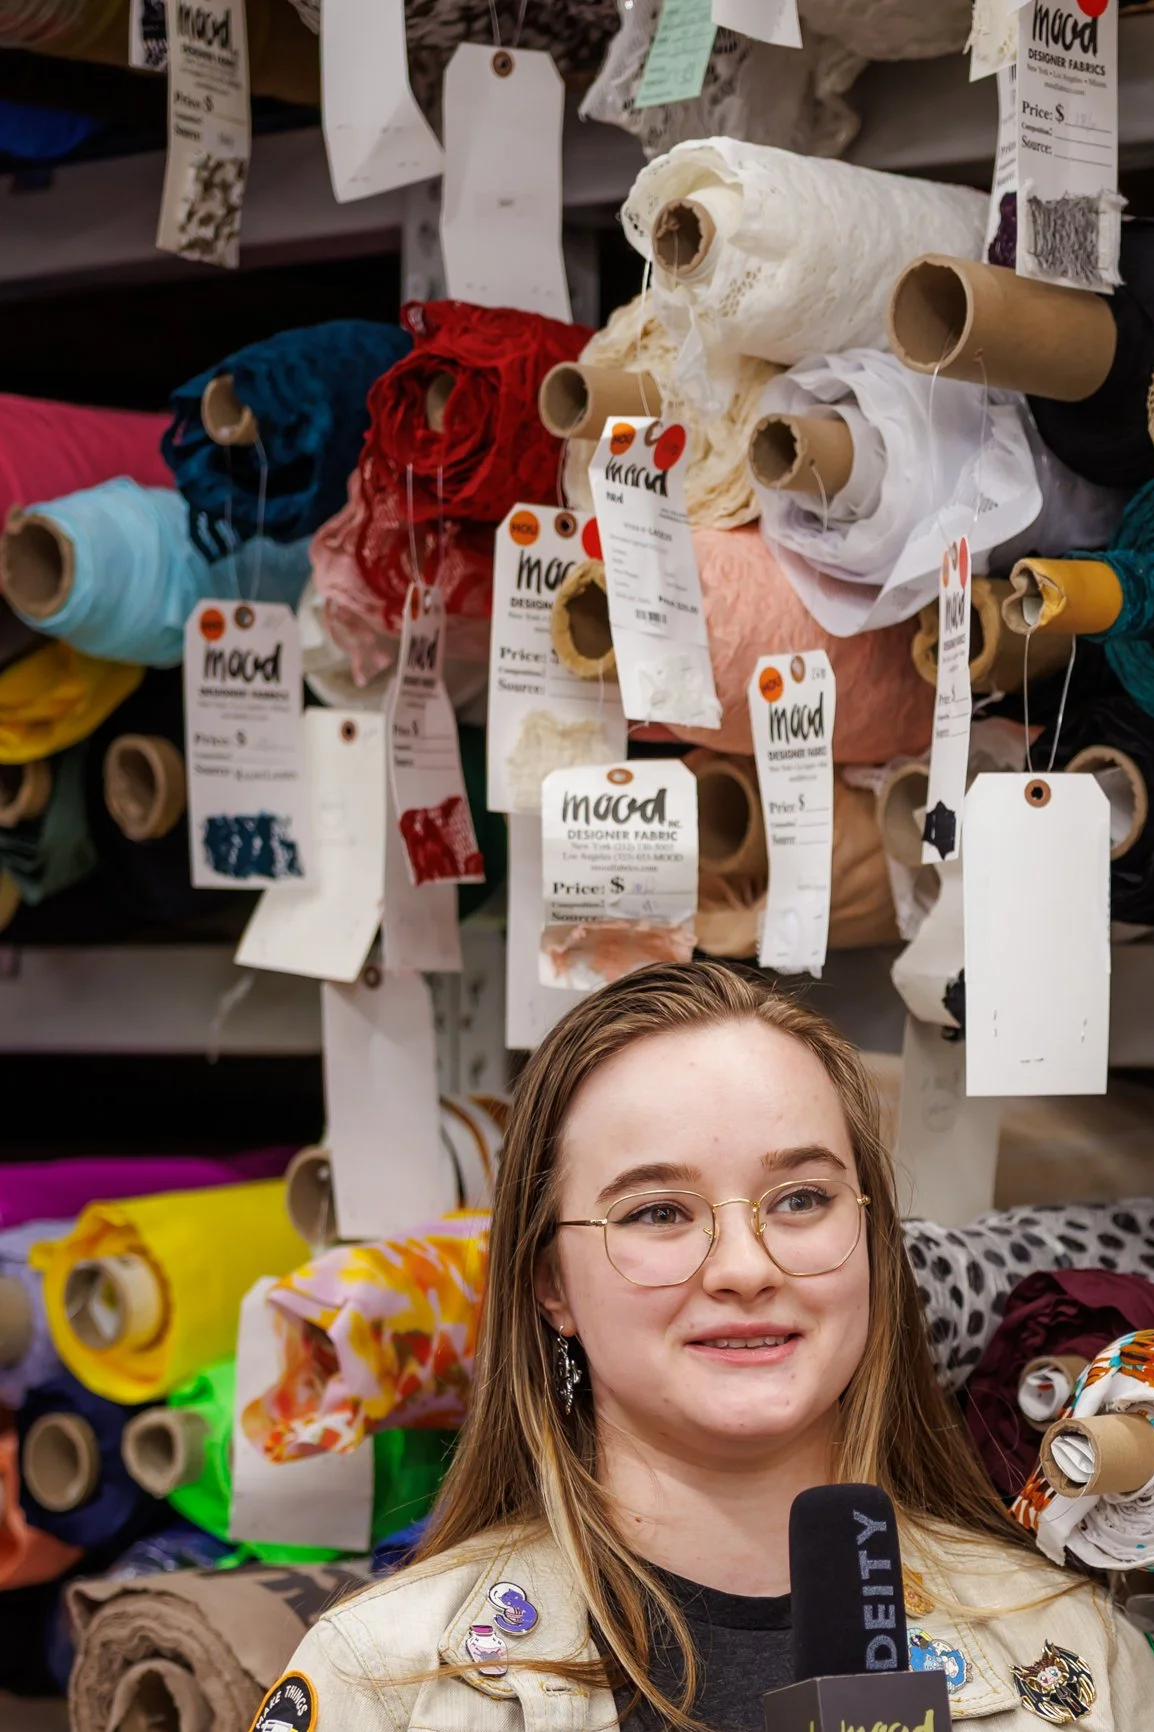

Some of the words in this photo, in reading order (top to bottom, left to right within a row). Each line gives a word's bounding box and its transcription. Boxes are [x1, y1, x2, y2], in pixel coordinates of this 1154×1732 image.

[1032, 0, 1098, 57] mood
[1028, 48, 1067, 69] DESIGNER
[1068, 59, 1106, 77] FABRICS
[1022, 100, 1053, 120] Price:
[1055, 103, 1065, 123] $
[1021, 135, 1053, 155] Source:
[516, 550, 575, 595] mo
[204, 642, 283, 685] mood
[500, 647, 547, 663] Price:
[769, 691, 825, 745] mood
[562, 788, 667, 826] mood
[567, 829, 629, 841] DESIGNER
[634, 831, 678, 841] FABRIC
[553, 881, 605, 895] Price:
[610, 876, 625, 895] $
[853, 1509, 898, 1671] DEITY
[284, 1684, 308, 1717] THINGS
